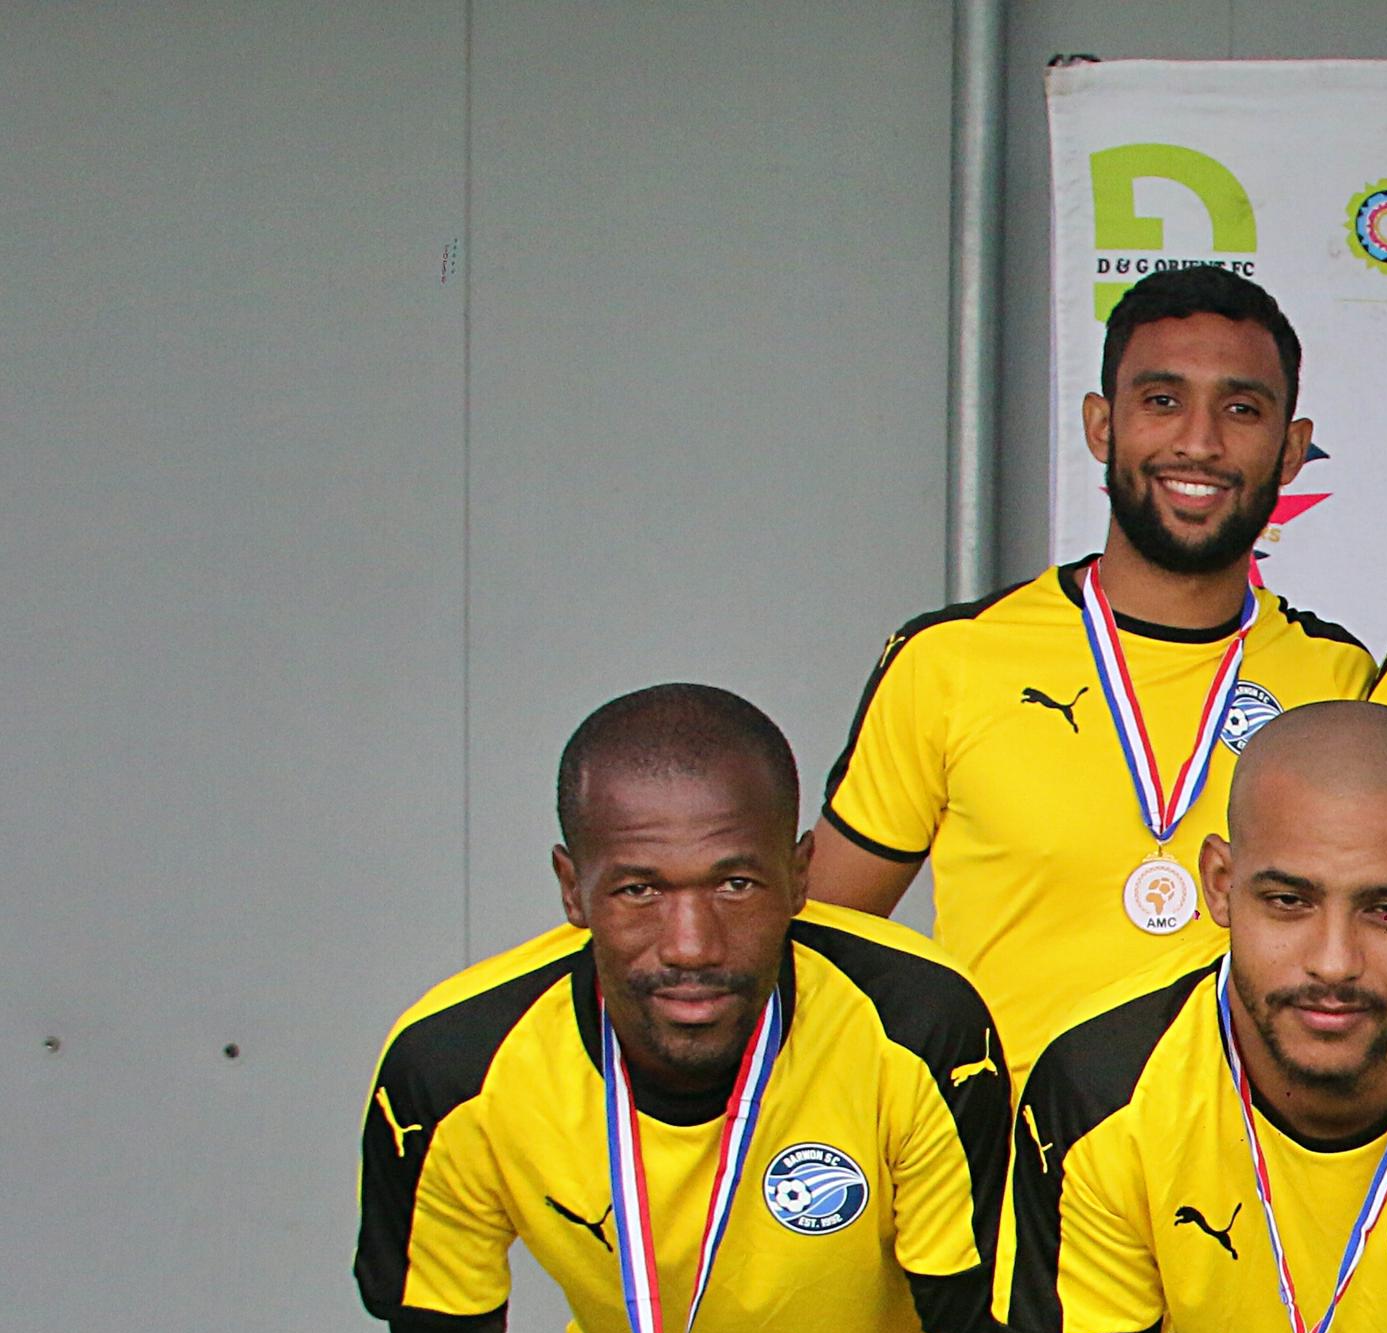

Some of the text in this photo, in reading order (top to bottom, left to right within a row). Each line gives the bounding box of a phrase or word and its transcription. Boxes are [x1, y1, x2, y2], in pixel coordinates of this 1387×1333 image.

[1097, 258, 1110, 273] D
[1116, 258, 1131, 274] &
[1136, 259, 1149, 274] G
[1232, 261, 1255, 276] FC
[1146, 917, 1177, 929] AMC
[782, 1150, 823, 1168] BARWON
[798, 1216, 820, 1228] EST.
